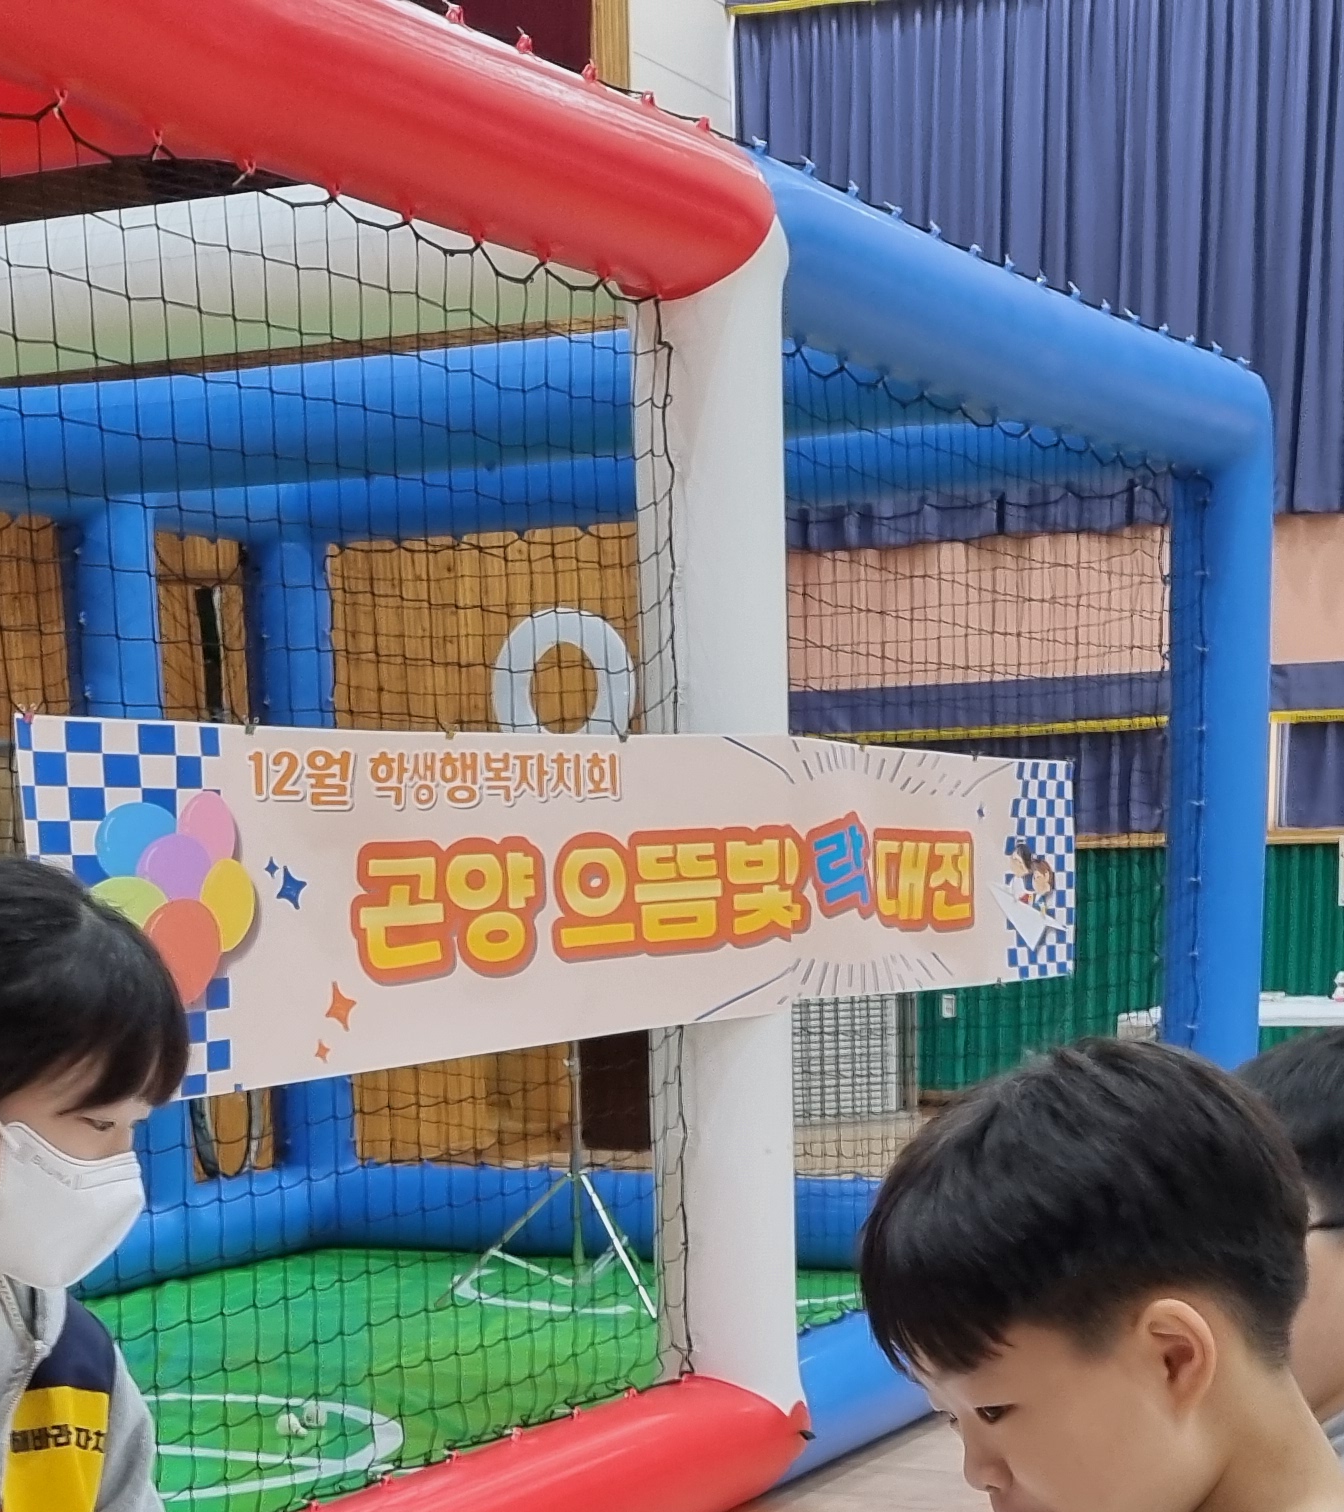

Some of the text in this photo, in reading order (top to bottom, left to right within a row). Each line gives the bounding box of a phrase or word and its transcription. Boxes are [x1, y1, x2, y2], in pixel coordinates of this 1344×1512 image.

[248, 749, 619, 807] 12월 학생행복자치회
[358, 850, 538, 970] 곤양
